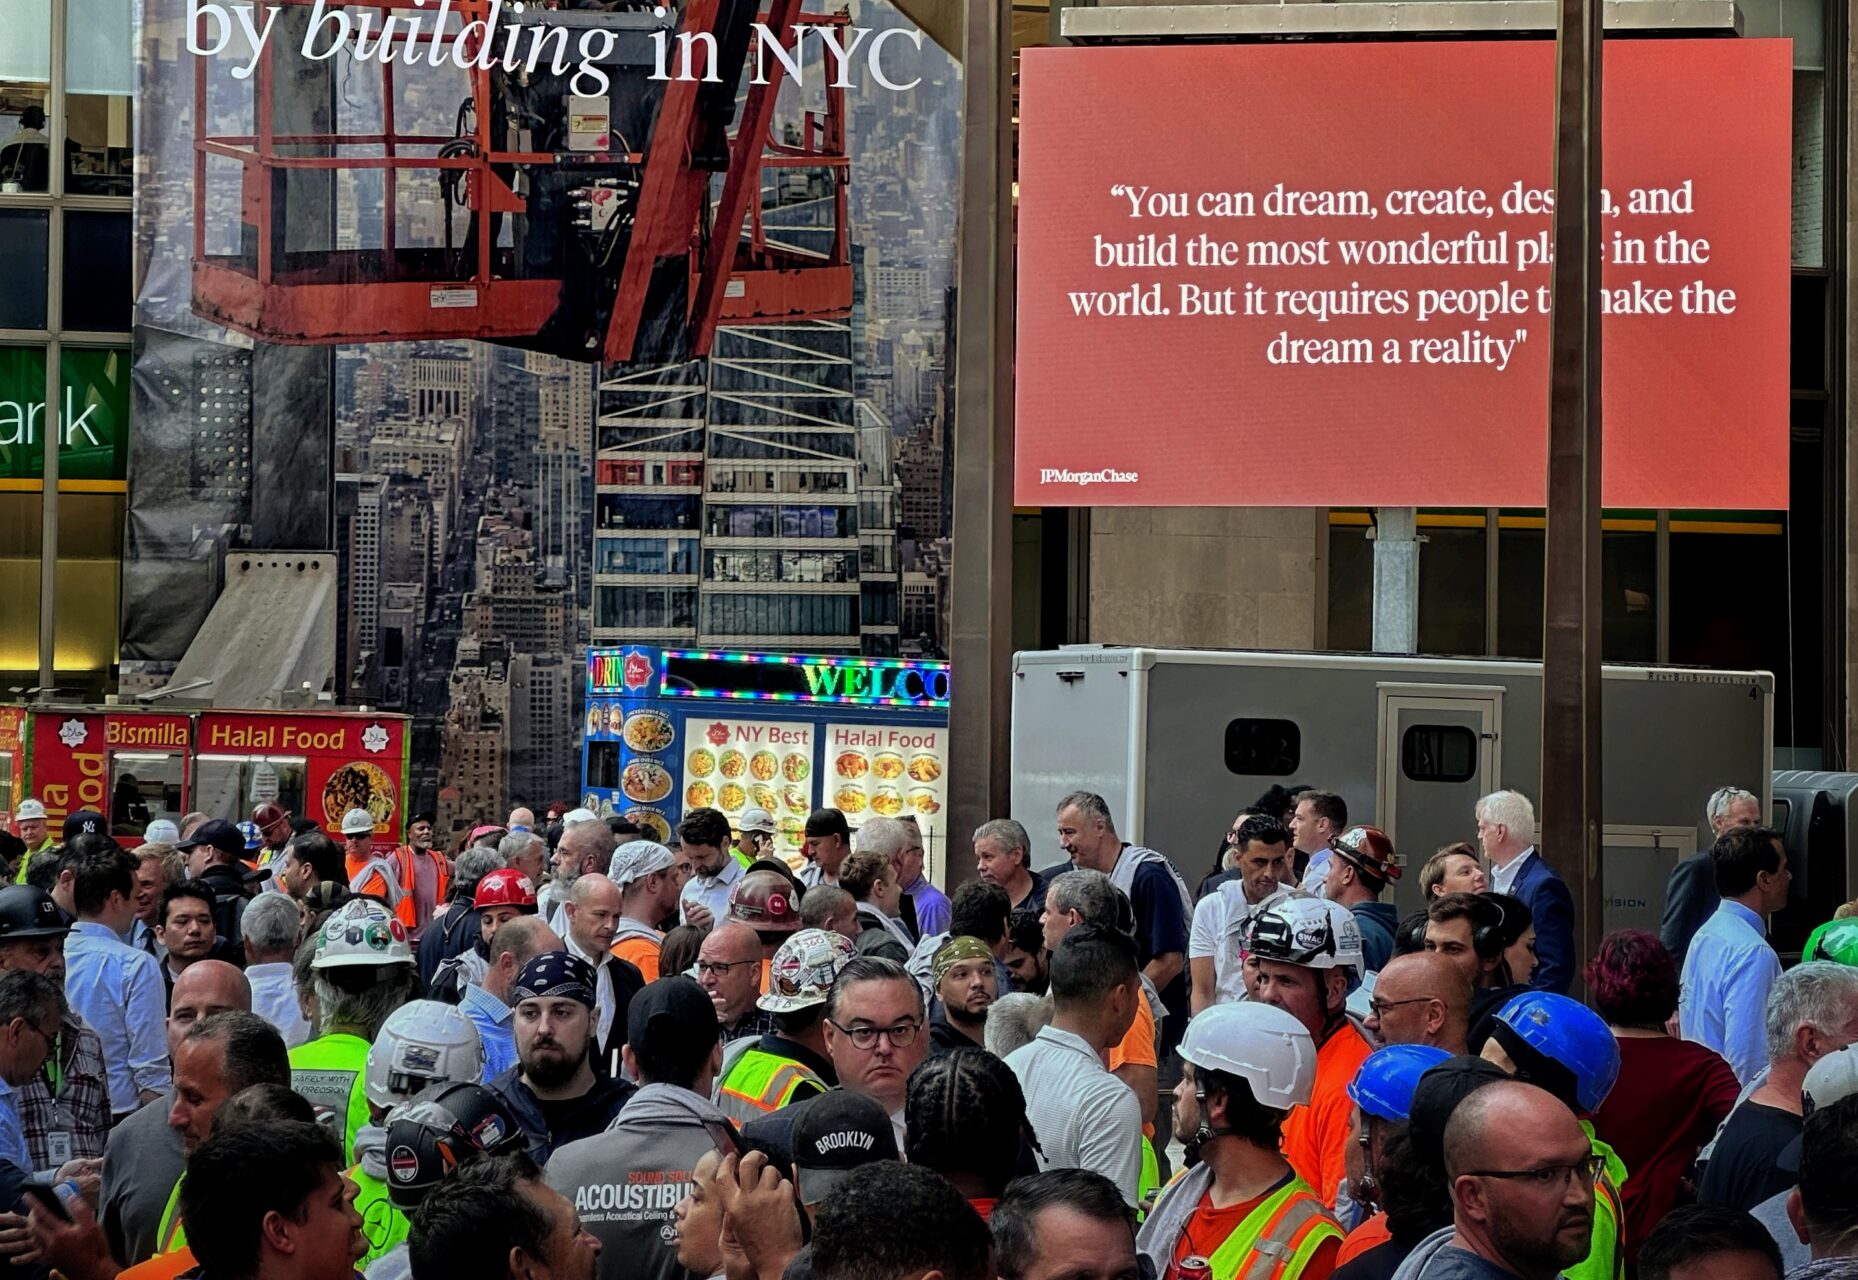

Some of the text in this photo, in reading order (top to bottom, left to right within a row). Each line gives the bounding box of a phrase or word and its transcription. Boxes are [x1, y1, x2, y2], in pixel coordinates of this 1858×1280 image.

[647, 6, 723, 84] in
[749, 22, 923, 92] NYC
[1196, 191, 1256, 217] can
[1263, 182, 1378, 220] dream,
[1385, 185, 1494, 219] create,
[1627, 180, 1694, 215] and
[1093, 232, 1179, 267] build
[1185, 232, 1239, 267] the
[1246, 236, 1330, 266] most
[1337, 230, 1509, 266] wonderful
[1612, 230, 1648, 265] in
[1654, 230, 1710, 265] the
[1067, 282, 1170, 317] world.
[1178, 283, 1237, 317] But
[1243, 282, 1268, 316] it
[1275, 281, 1410, 322] requires
[1416, 280, 1529, 322] people
[1536, 284, 1552, 315] t
[1680, 280, 1736, 315] the
[1267, 331, 1374, 365] dream
[1382, 338, 1402, 364] a
[1040, 468, 1139, 486] JPMorganChase
[1749, 687, 1757, 700] 4
[106, 722, 188, 745] Bismilla
[211, 723, 345, 750] Halal Food
[735, 725, 809, 745] NY Best
[834, 728, 936, 749] Halal Food
[301, 1086, 346, 1094] PRECISION
[815, 1130, 875, 1155] BROOKLYN
[628, 1171, 665, 1185] SOUND
[606, 1210, 643, 1221] Acoustical
[643, 1209, 668, 1222] Ceiling
